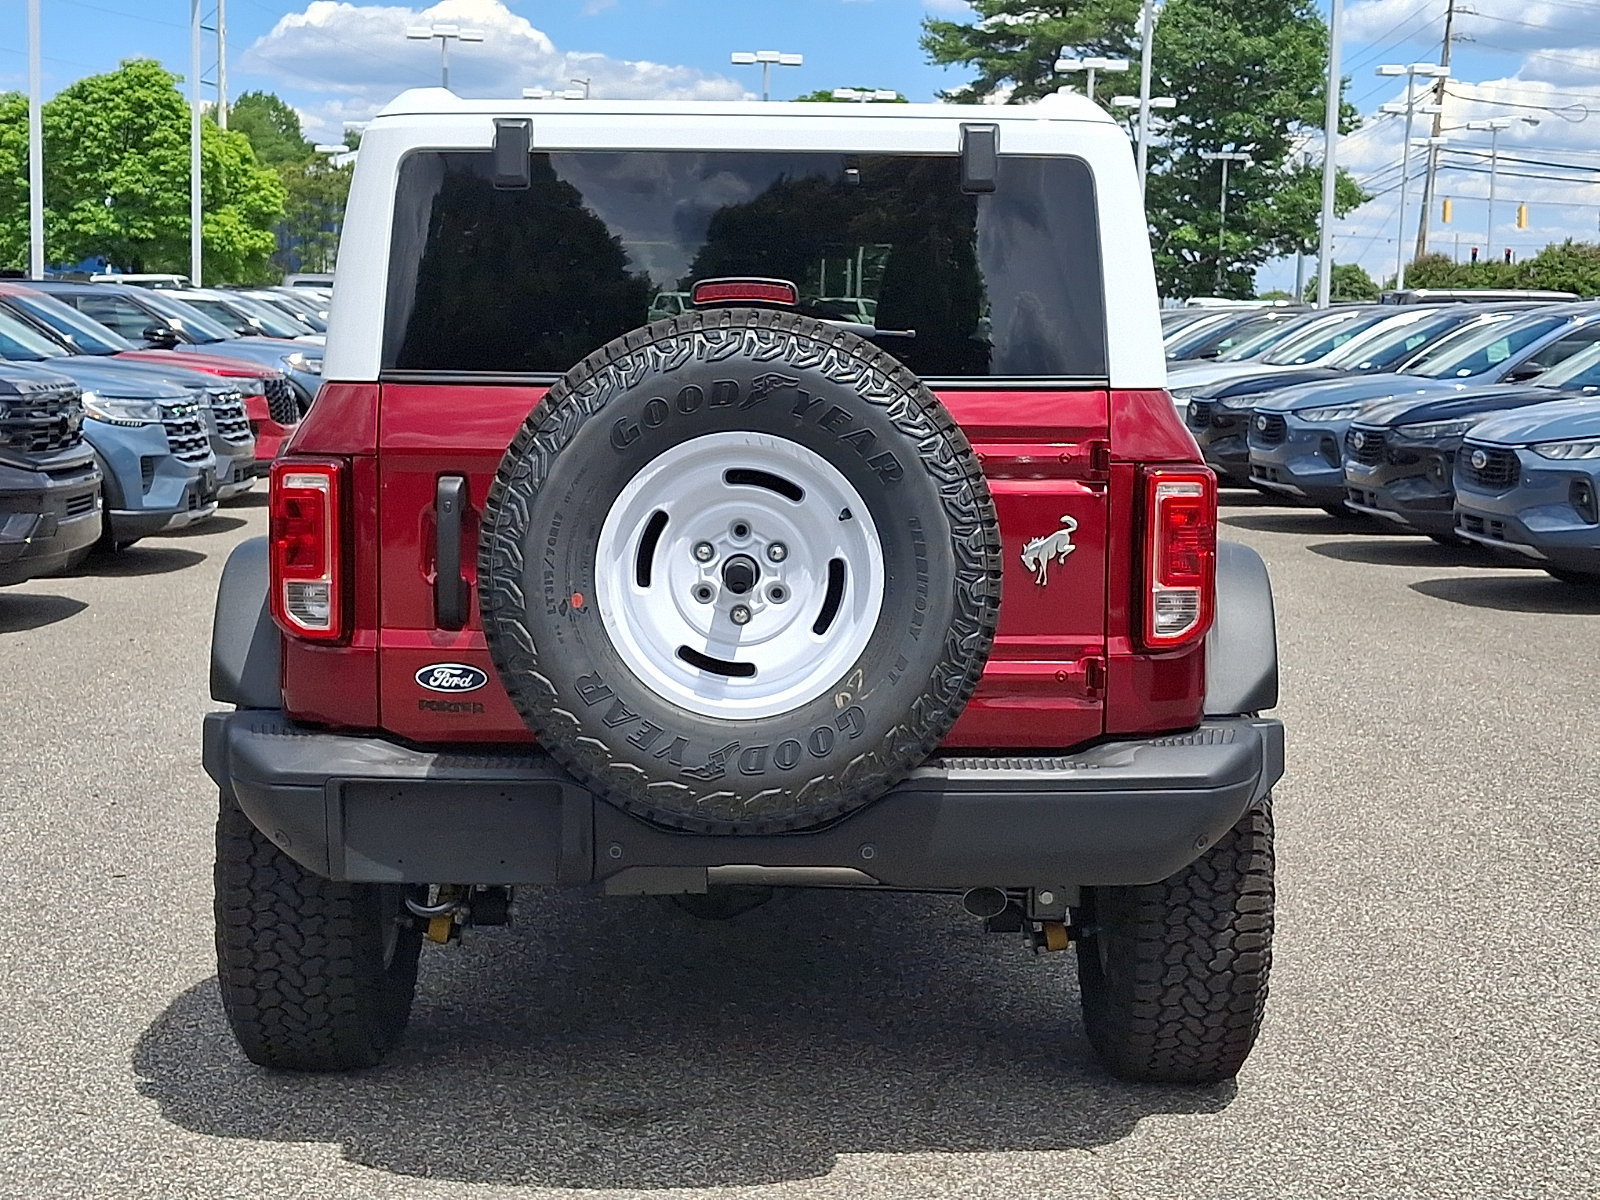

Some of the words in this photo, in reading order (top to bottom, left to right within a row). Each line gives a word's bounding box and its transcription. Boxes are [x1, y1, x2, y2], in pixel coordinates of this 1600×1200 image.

[610, 378, 740, 450] GOOD
[792, 388, 906, 486] YEAR
[428, 667, 474, 688] Ford
[574, 670, 690, 766] YEAR
[737, 704, 868, 775] GOOD
